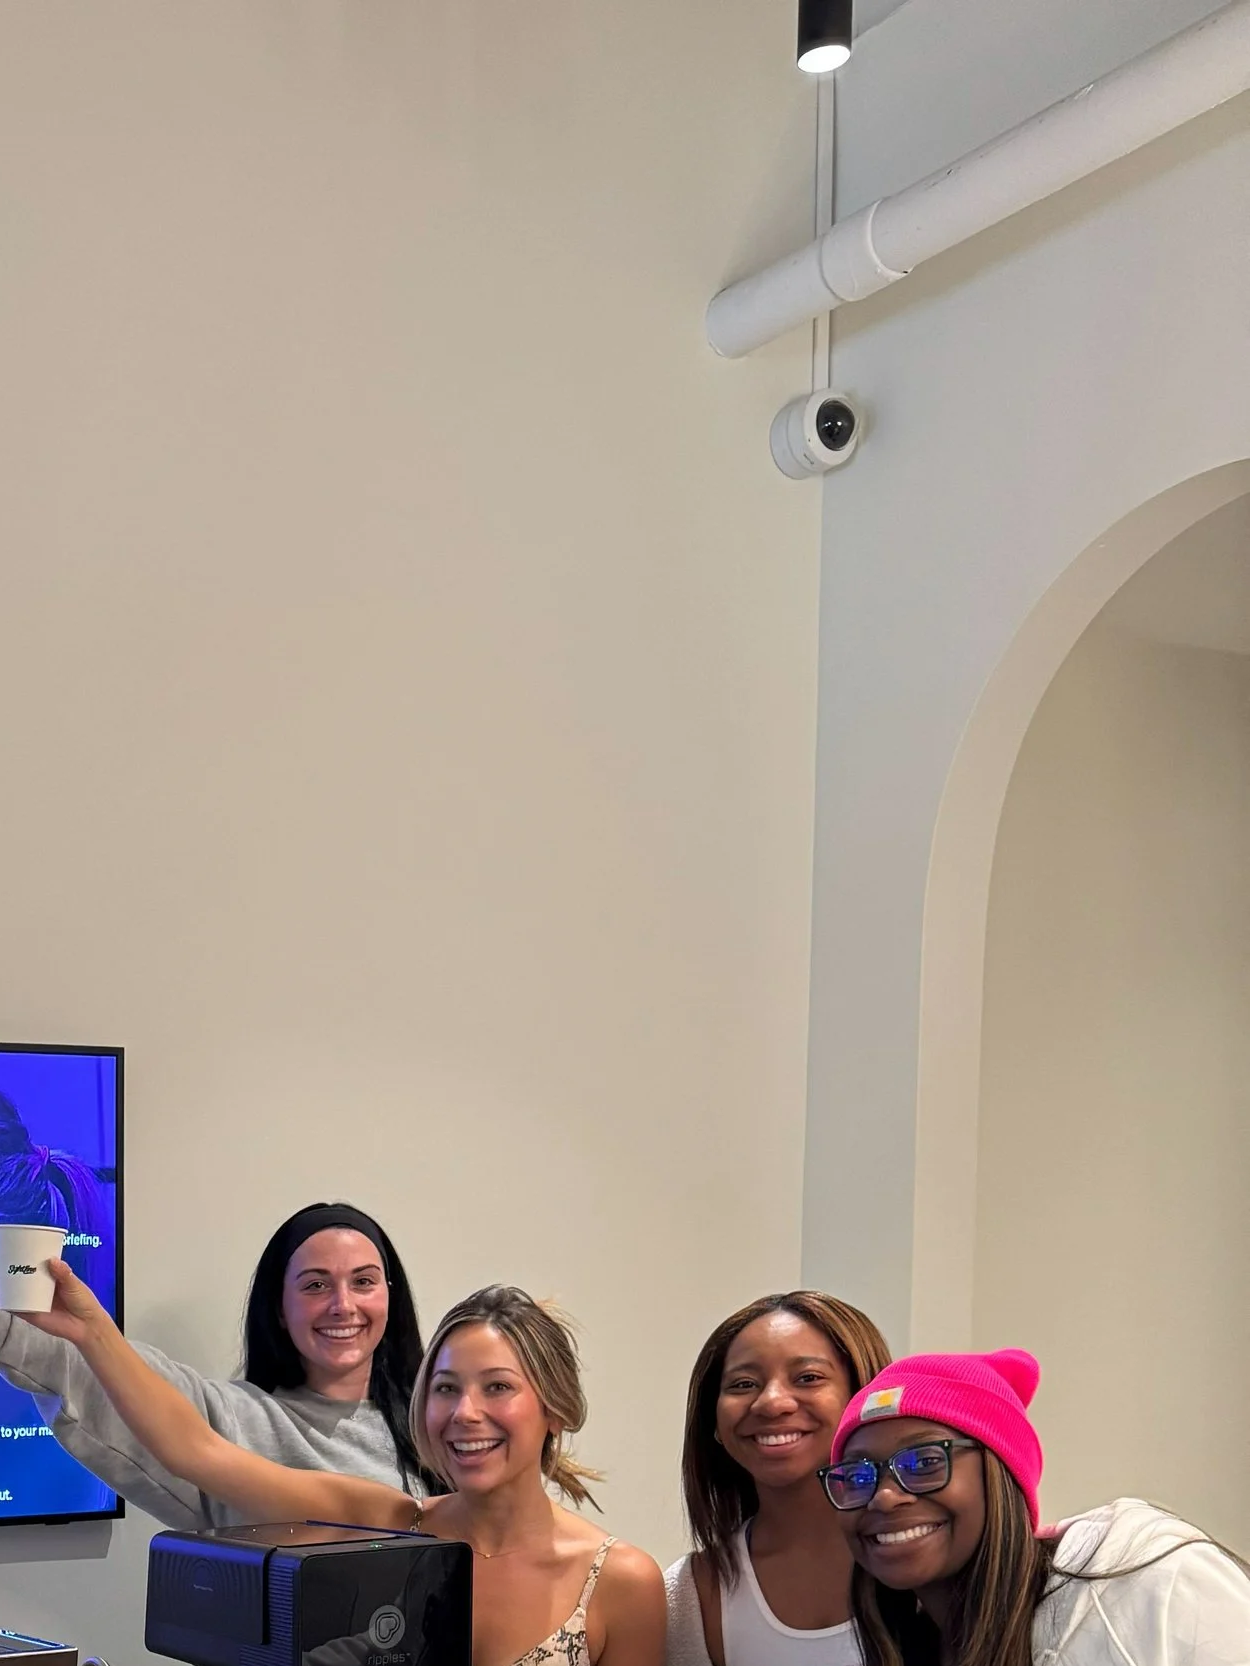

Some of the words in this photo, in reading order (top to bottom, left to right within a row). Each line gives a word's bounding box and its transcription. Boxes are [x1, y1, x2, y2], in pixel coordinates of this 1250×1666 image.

[0, 1426, 12, 1438] to
[13, 1426, 38, 1440] your
[367, 1652, 406, 1666] ripples
